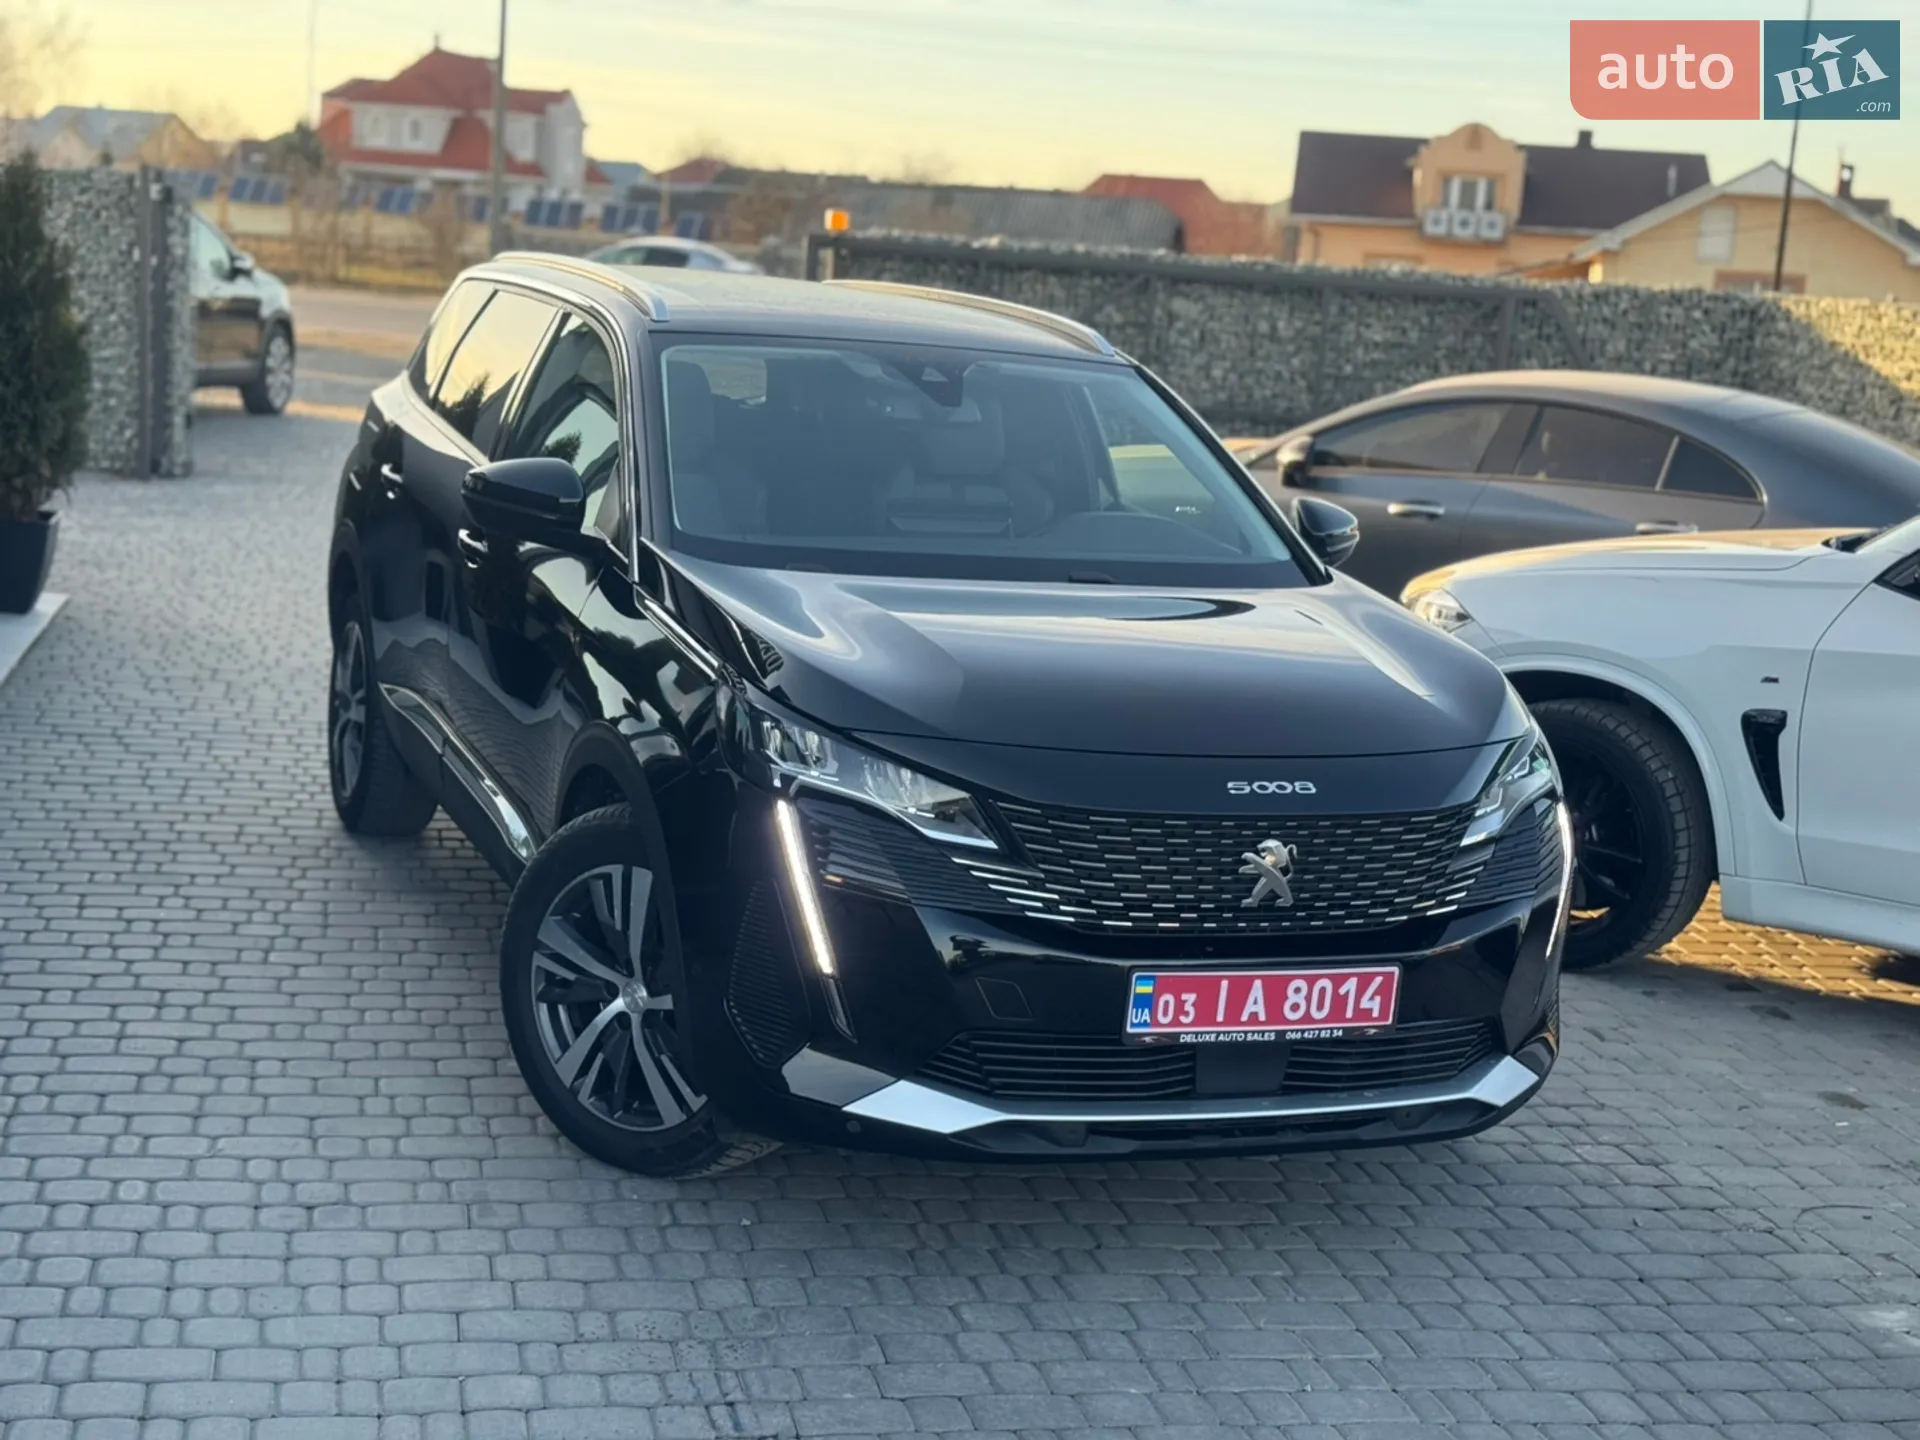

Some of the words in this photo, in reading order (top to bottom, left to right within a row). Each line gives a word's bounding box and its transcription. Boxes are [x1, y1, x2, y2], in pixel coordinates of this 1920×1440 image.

[1227, 781, 1317, 794] 5008
[1157, 992, 1198, 1025] 03
[1282, 975, 1385, 1022] 8014
[1132, 1007, 1151, 1024] UA
[1179, 1033, 1217, 1043] DELUXE
[1217, 1032, 1245, 1042] AUTO
[1246, 1031, 1276, 1041] SALES
